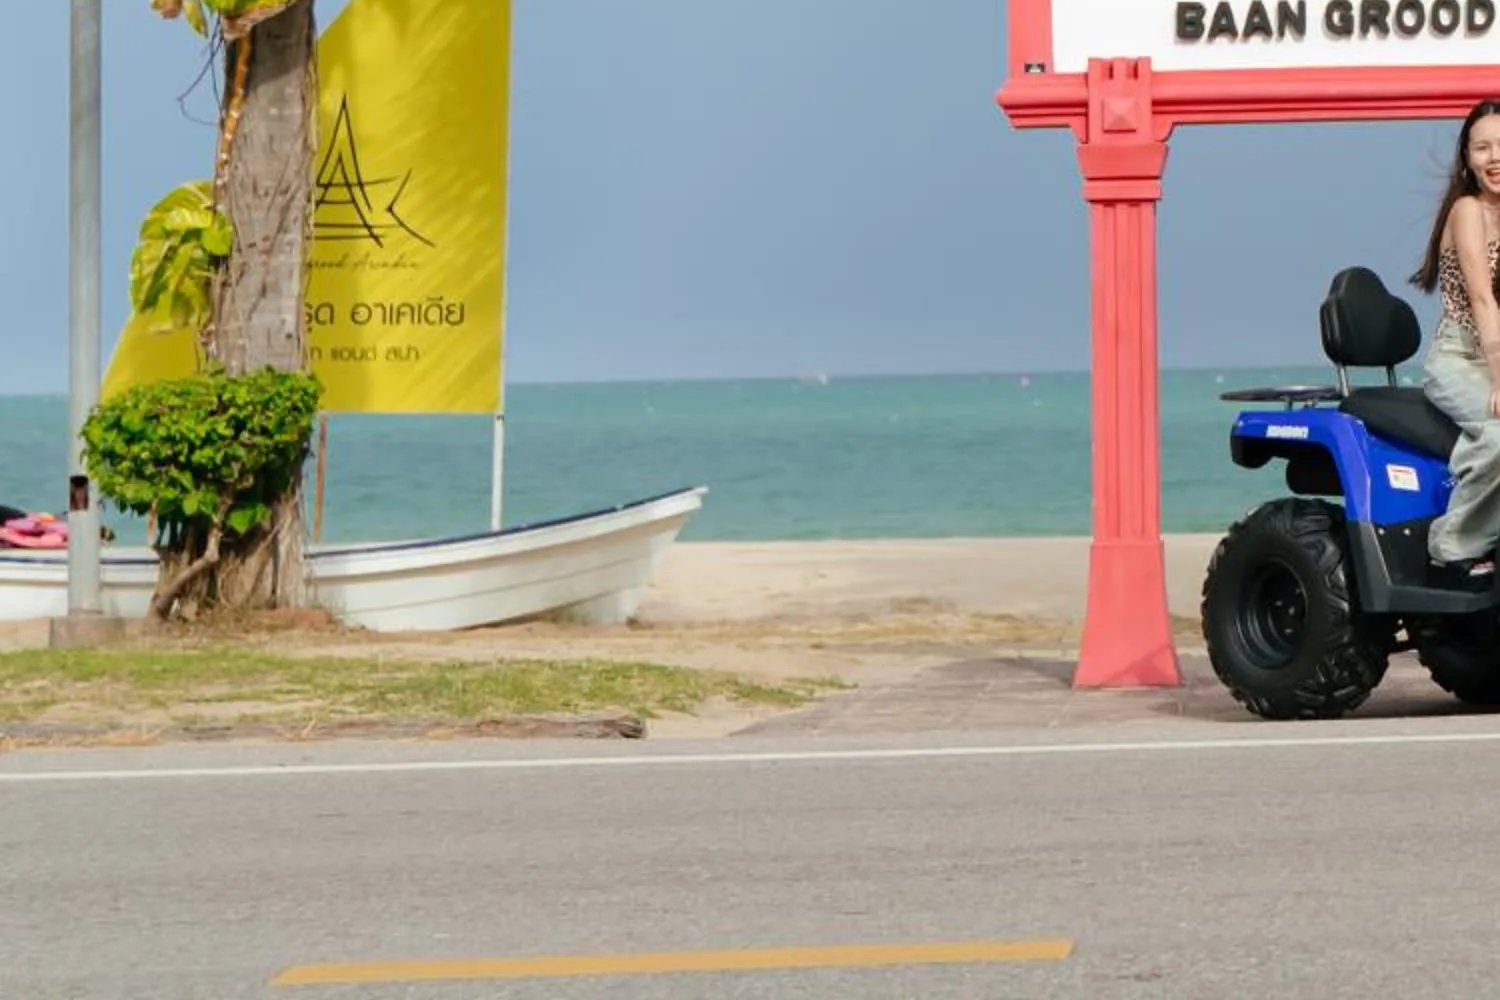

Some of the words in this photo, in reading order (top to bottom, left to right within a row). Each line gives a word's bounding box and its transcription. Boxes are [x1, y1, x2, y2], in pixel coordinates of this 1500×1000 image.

[1175, 0, 1306, 40] BAAN
[350, 295, 466, 326] อาเคเดีย
